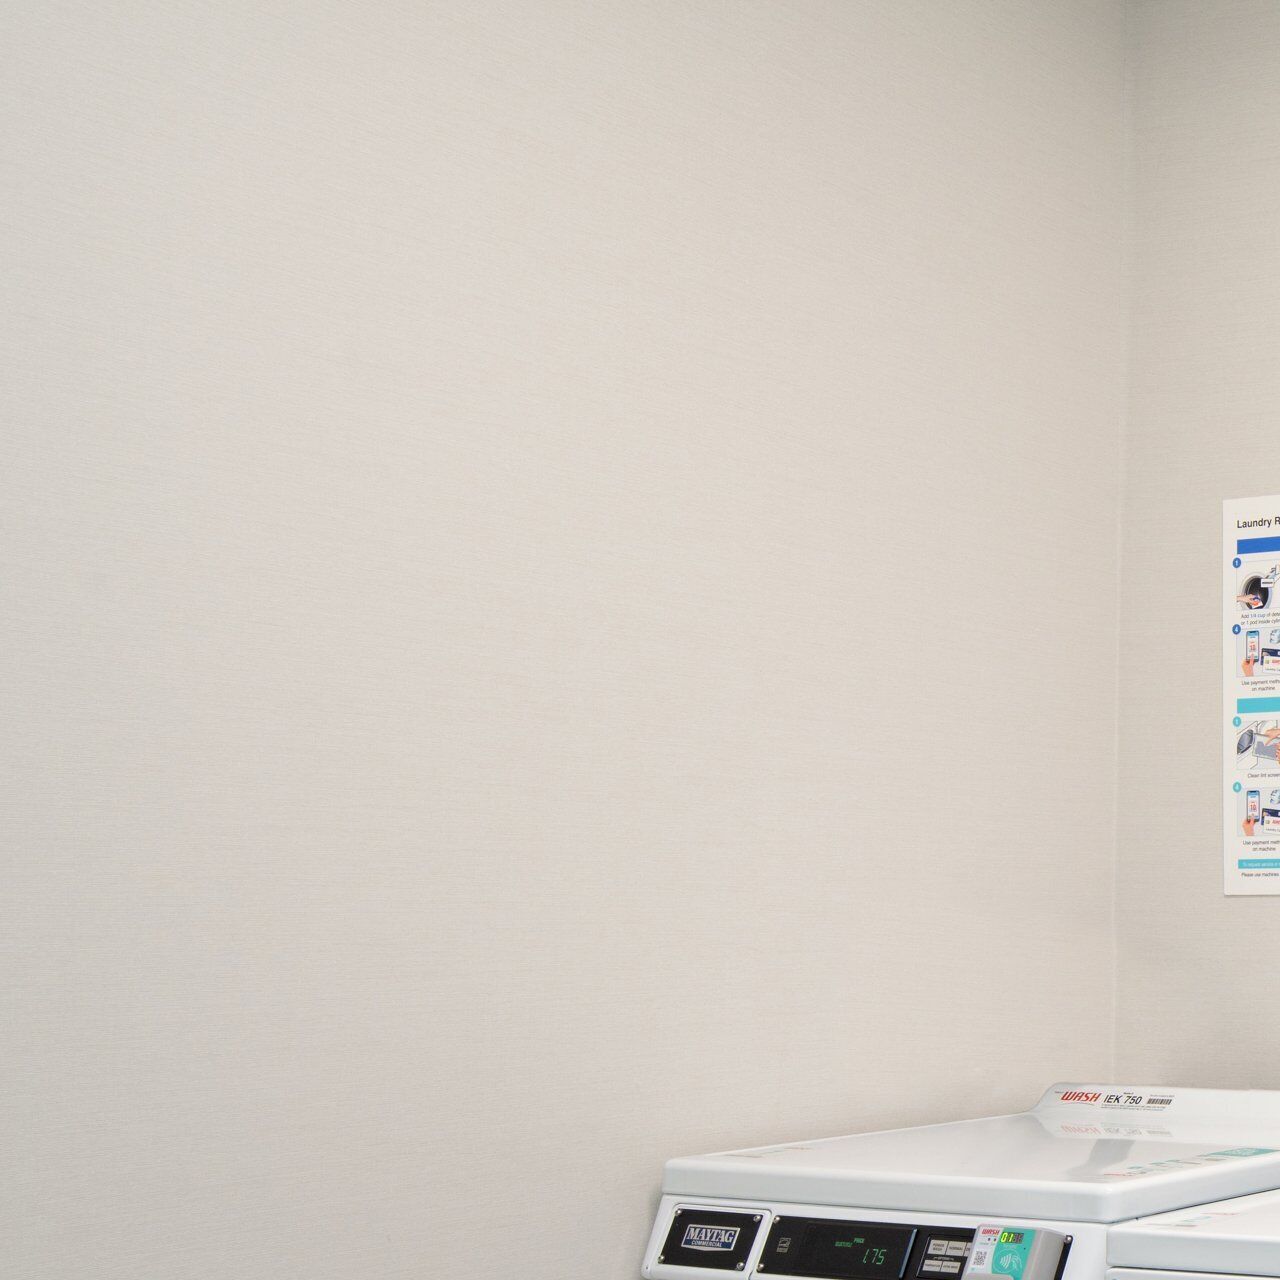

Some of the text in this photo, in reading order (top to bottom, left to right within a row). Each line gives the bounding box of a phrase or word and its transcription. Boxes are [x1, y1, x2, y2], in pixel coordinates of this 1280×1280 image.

[1237, 518, 1272, 528] Laundry
[1061, 1092, 1102, 1101] WASH
[1104, 1095, 1142, 1104] IEK 750
[688, 1228, 735, 1242] MAYTAG
